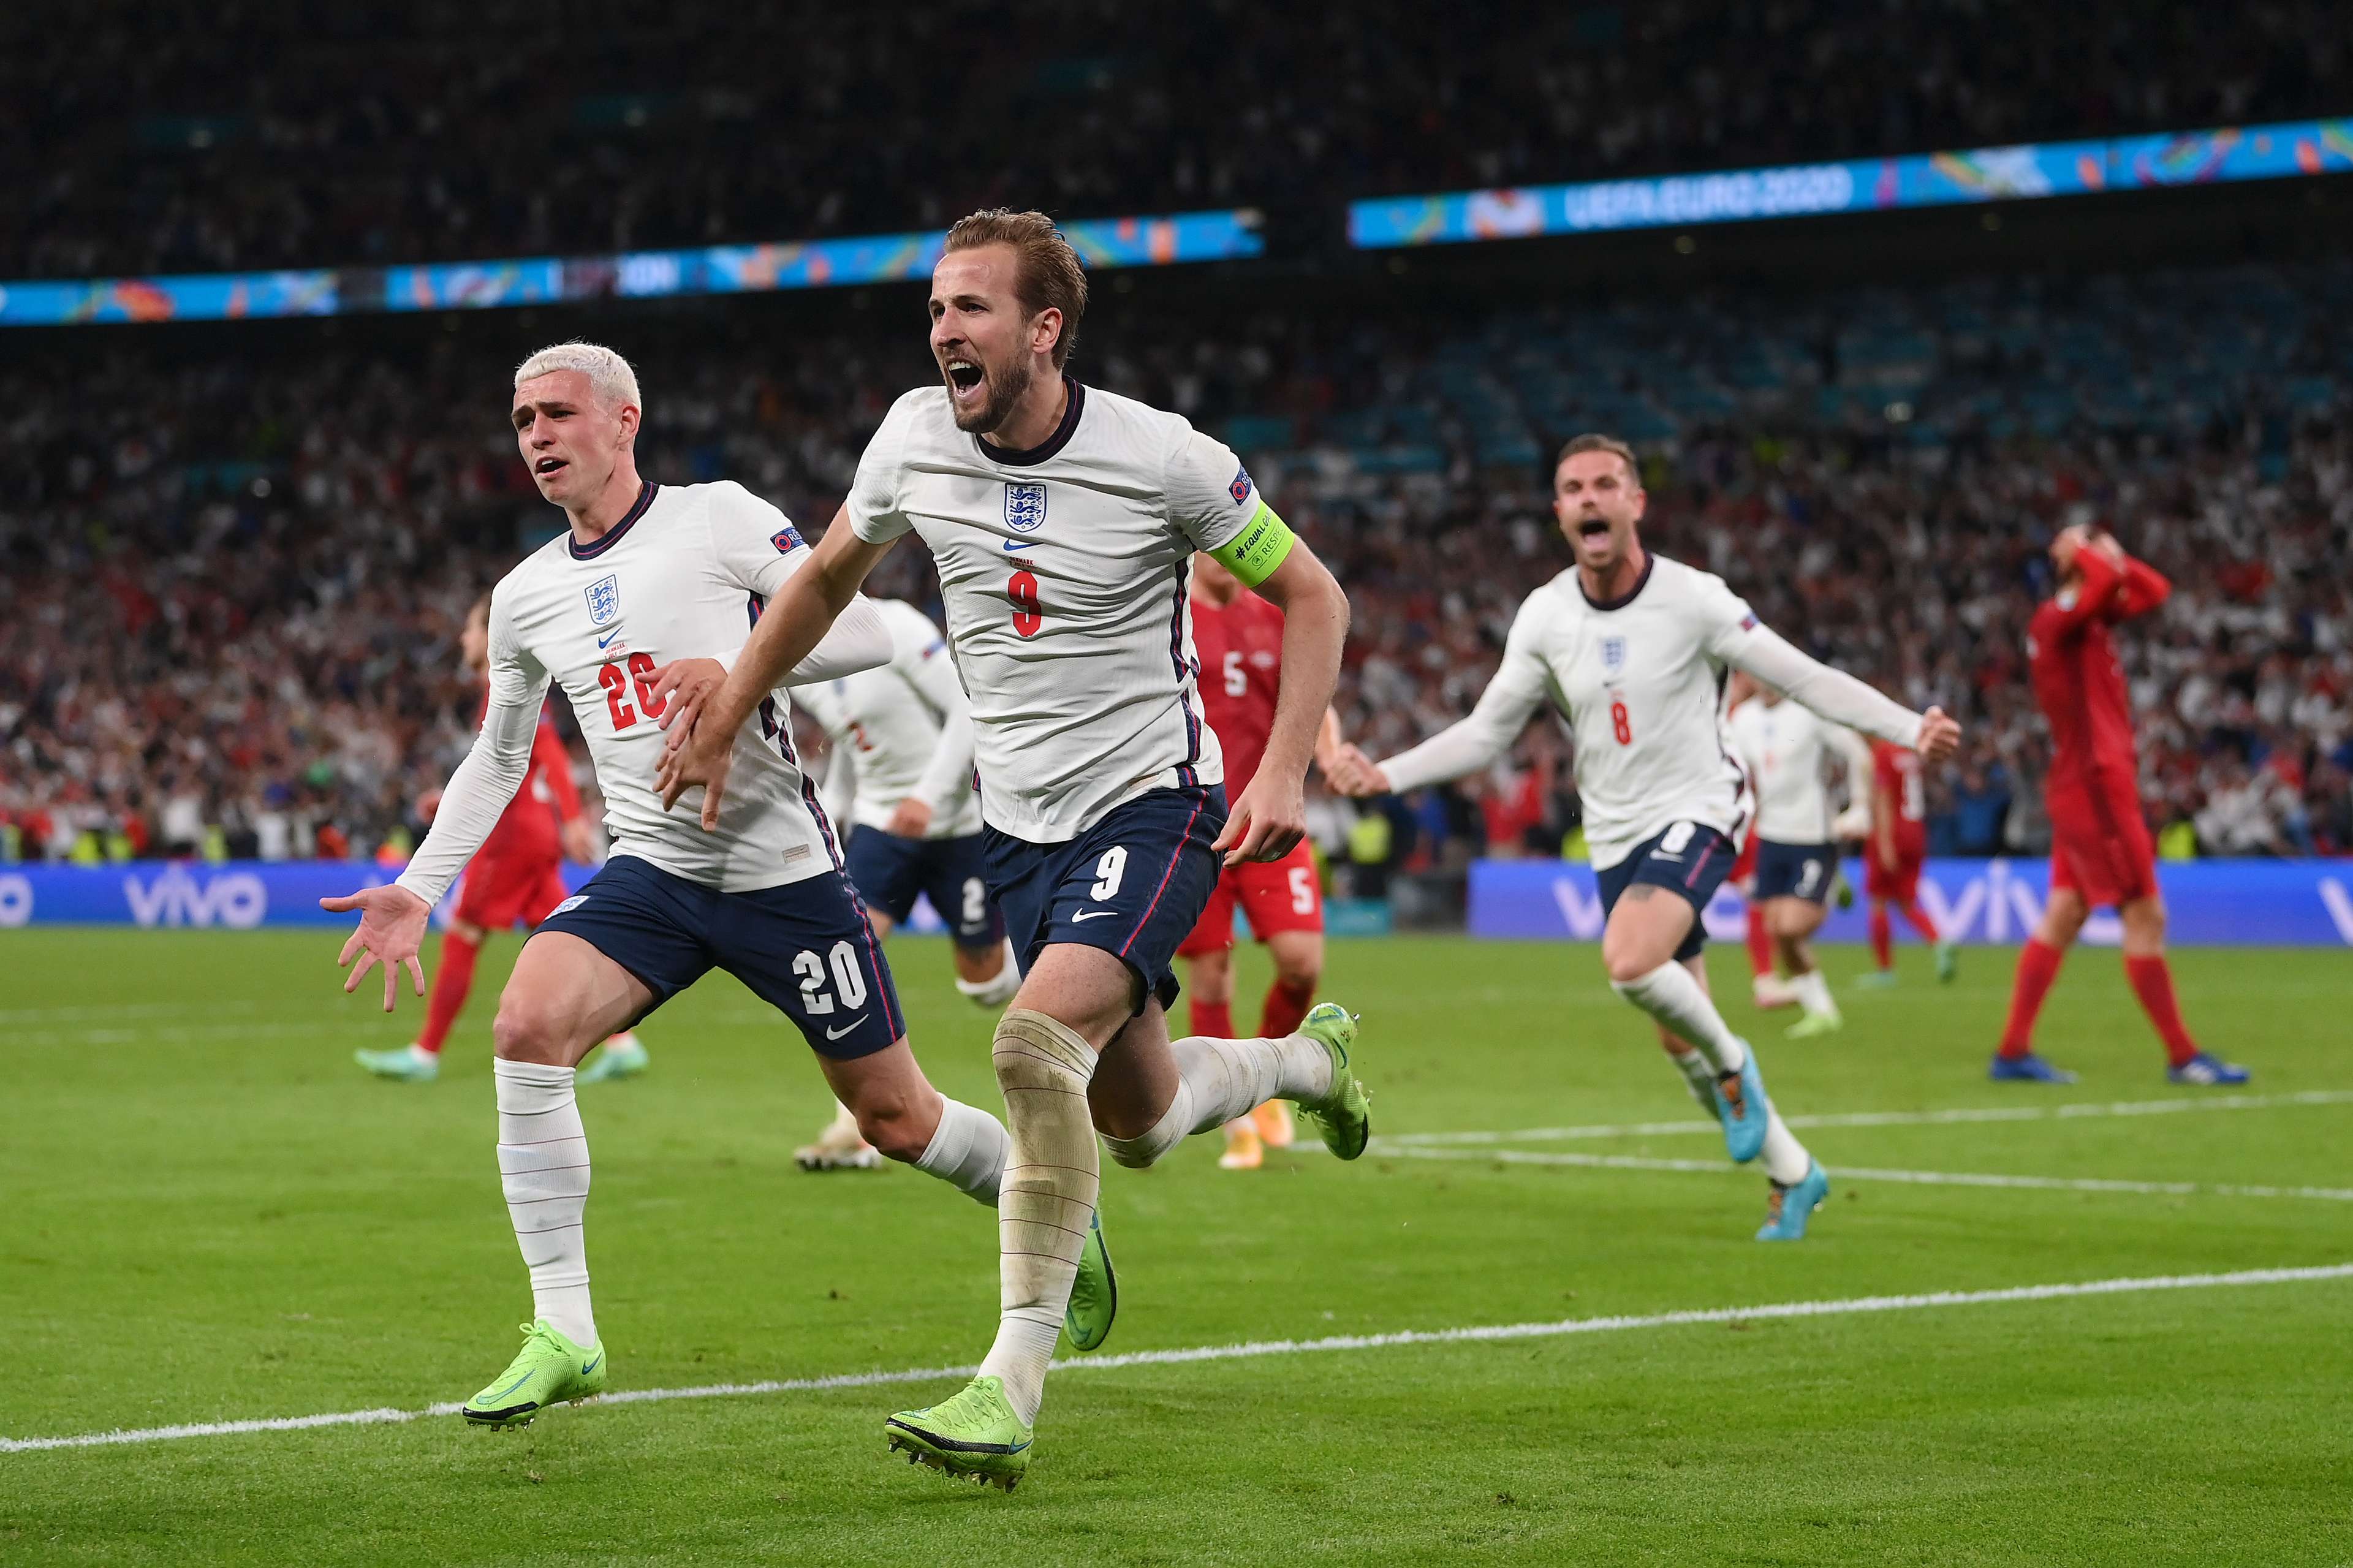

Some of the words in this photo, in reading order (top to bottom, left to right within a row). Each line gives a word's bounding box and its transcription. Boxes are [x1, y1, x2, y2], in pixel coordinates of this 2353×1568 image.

[1564, 182, 1654, 229] UEFA
[1658, 173, 1755, 222] EURO
[1757, 164, 1854, 215] 2020
[1008, 571, 1042, 637] 9
[1223, 650, 1248, 697] 5
[1610, 701, 1632, 746] 8
[961, 876, 986, 920] 2
[1089, 846, 1128, 902] 9
[1287, 867, 1314, 915] 5
[792, 941, 867, 1015] 20
